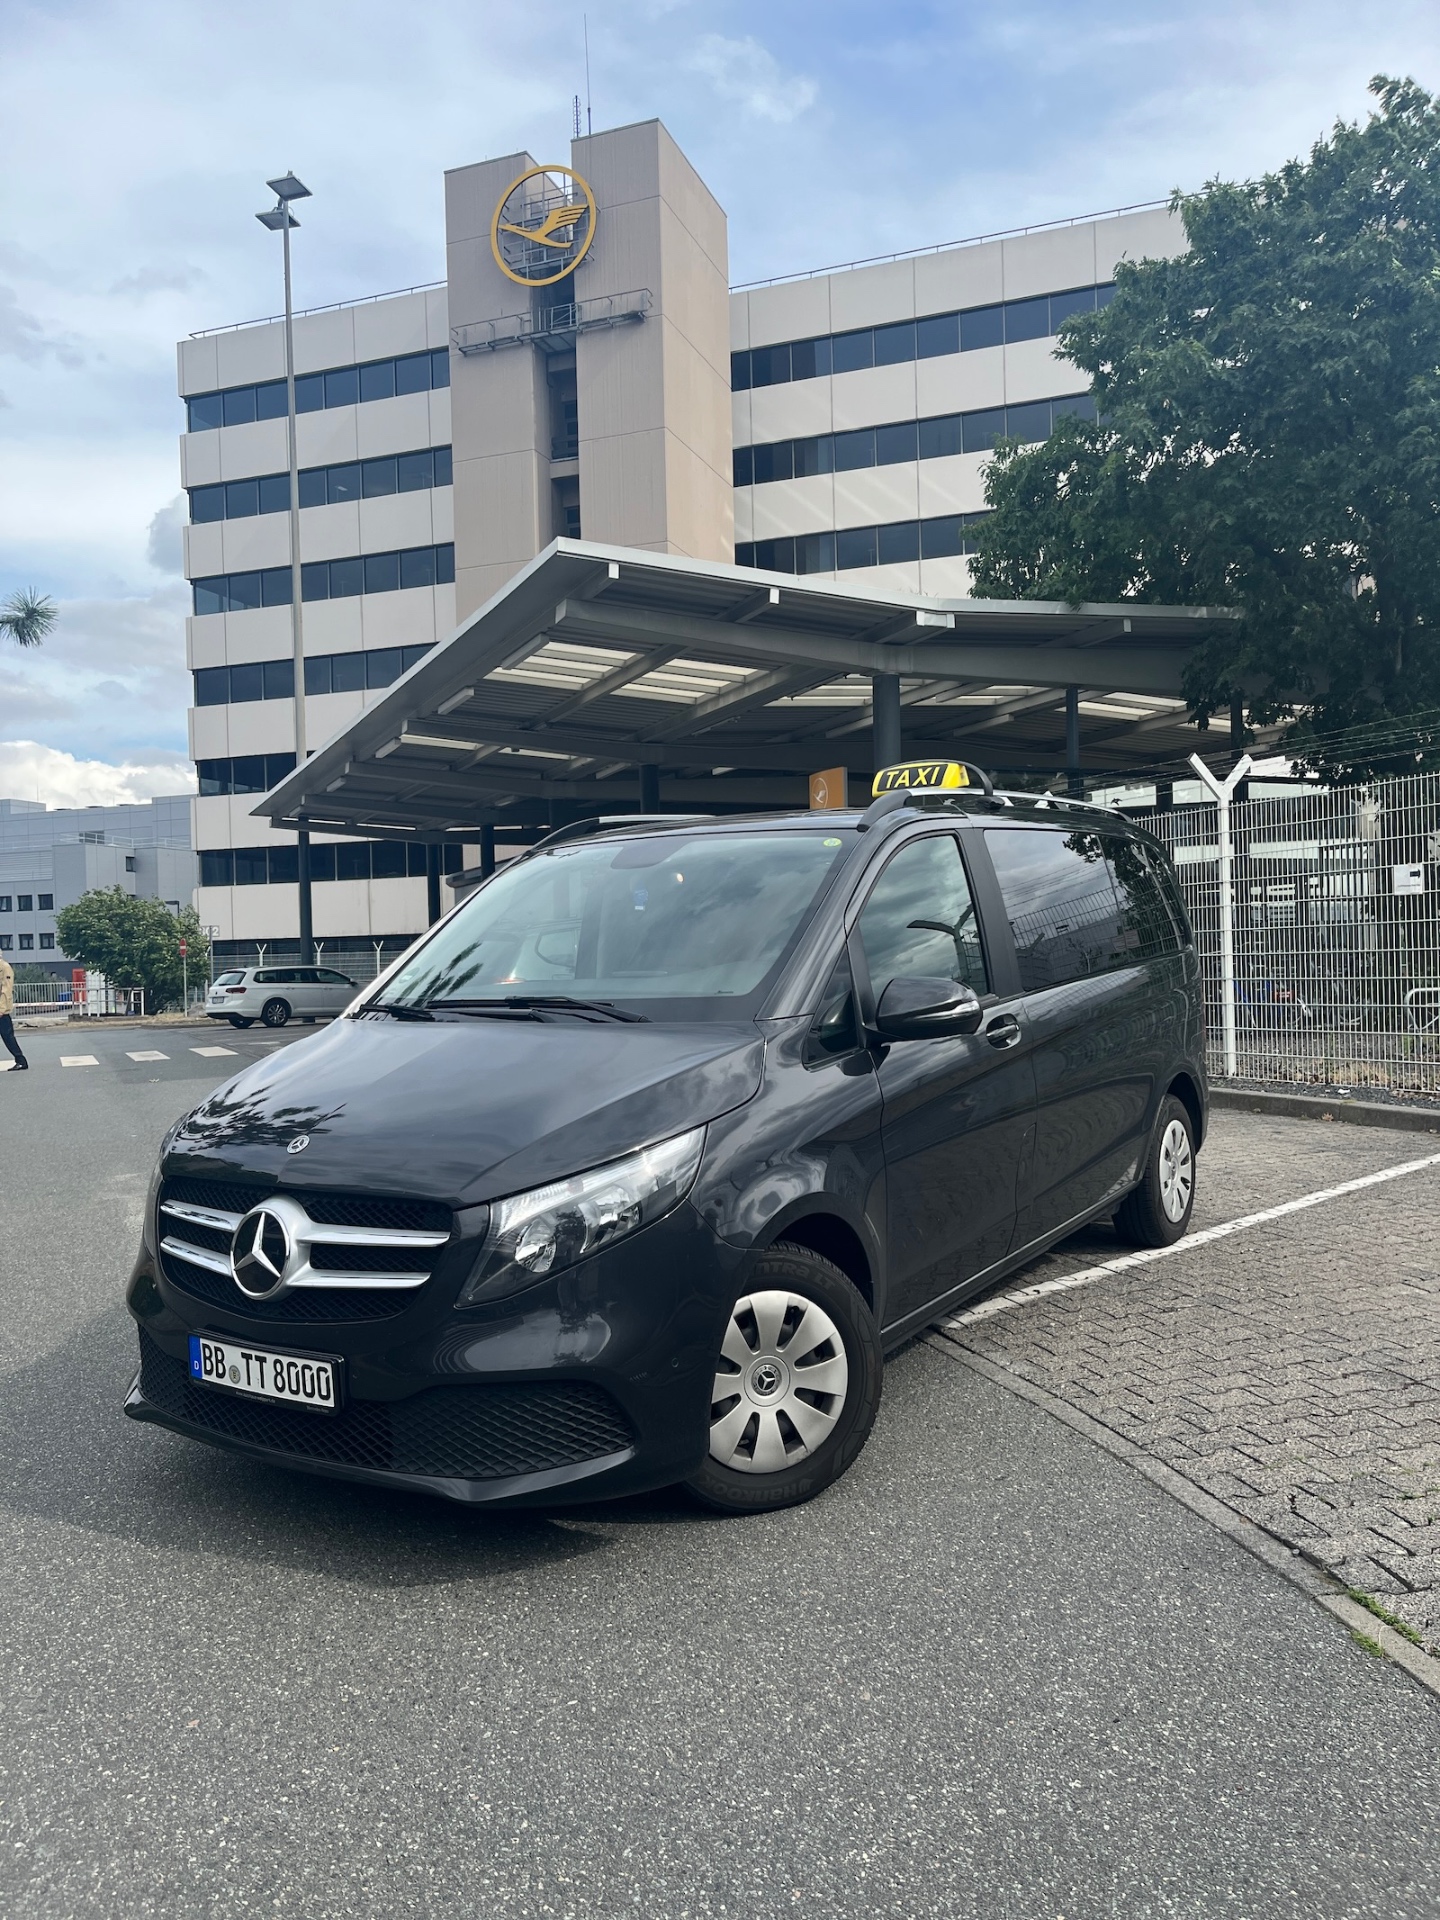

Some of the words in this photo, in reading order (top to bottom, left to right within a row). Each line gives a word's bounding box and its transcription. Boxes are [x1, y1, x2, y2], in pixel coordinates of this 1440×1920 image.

[886, 766, 941, 789] TAXI
[194, 1360, 200, 1370] D
[202, 1342, 226, 1379] BB
[241, 1352, 267, 1389] TT
[273, 1358, 331, 1401] 8000
